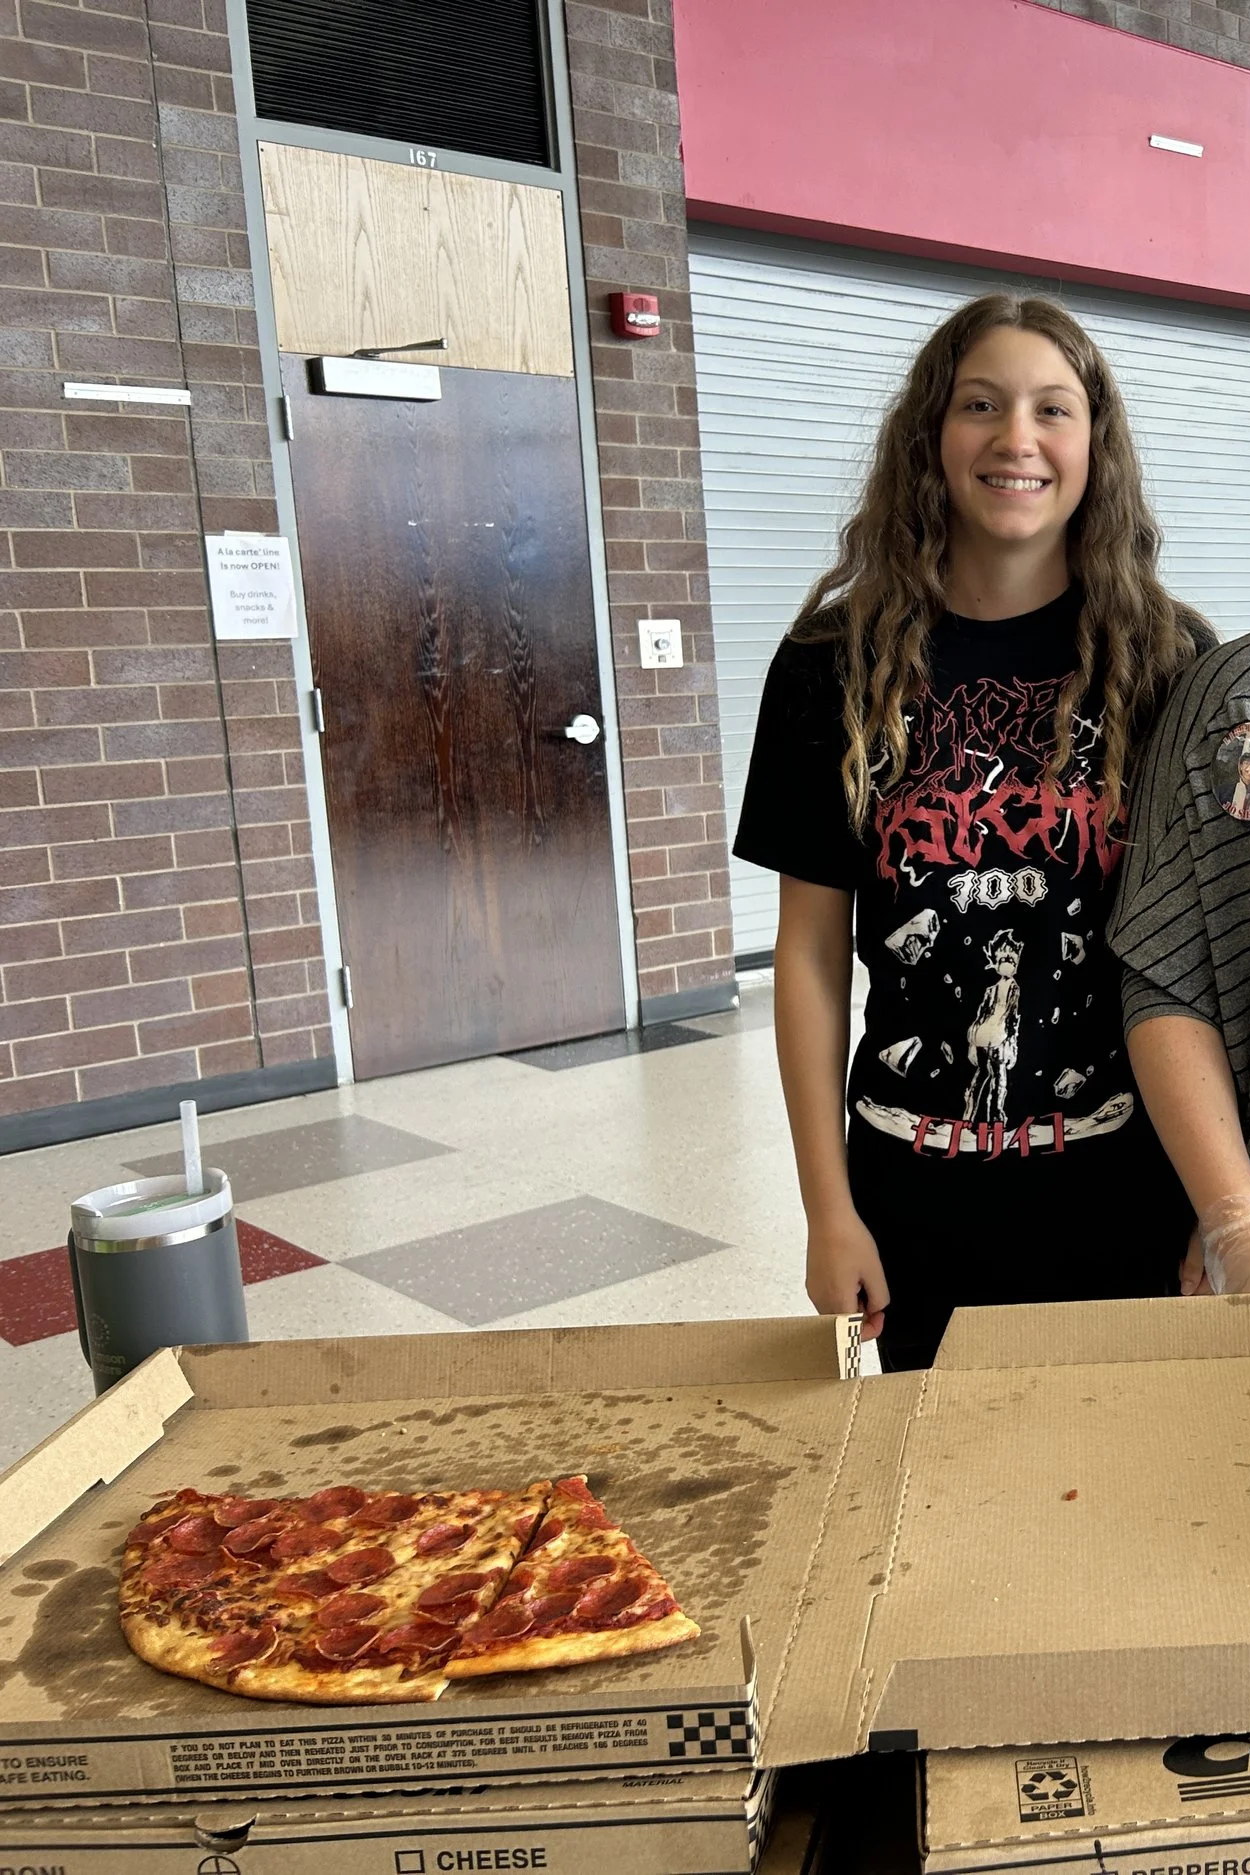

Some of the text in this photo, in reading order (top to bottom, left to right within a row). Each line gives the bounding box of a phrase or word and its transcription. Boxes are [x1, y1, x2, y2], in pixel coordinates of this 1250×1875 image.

[409, 148, 437, 168] 167
[947, 866, 1048, 914] 100
[172, 1753, 208, 1762] DEGREES
[212, 1753, 224, 1761] OR
[227, 1751, 256, 1760] BELOW
[259, 1750, 276, 1758] AND
[280, 1748, 301, 1757] THEN
[305, 1746, 345, 1756] REHEATED
[350, 1745, 369, 1753] JUST
[373, 1743, 398, 1752] PRIOR
[401, 1742, 412, 1750] TO
[416, 1739, 476, 1750] CONSUMPTION.
[500, 1736, 520, 1744] BEST
[523, 1734, 558, 1743] RESULTS
[561, 1732, 594, 1741] REMOVE
[598, 1730, 621, 1739] PIZZA
[624, 1729, 648, 1737] FROM
[181, 1744, 198, 1752] YOU
[202, 1743, 214, 1751] DO
[219, 1742, 235, 1750] NOT
[239, 1741, 261, 1749] PLAN
[264, 1740, 276, 1748] TO
[280, 1739, 294, 1747] EAT
[298, 1738, 317, 1746] THIS
[321, 1736, 345, 1745] PIZZA
[348, 1735, 377, 1744] WITHIN
[451, 1727, 493, 1738] PURCHASE
[560, 1720, 619, 1731] REFRIGERATED
[622, 1719, 633, 1727] AT
[3, 1754, 89, 1769] TO ENSURE
[216, 1761, 242, 1770] PLACE
[280, 1758, 301, 1767] OVEN
[306, 1757, 344, 1766] DIRECTLY
[349, 1756, 360, 1764] ON
[384, 1753, 406, 1761] OVEN
[411, 1751, 433, 1760] RACK
[512, 1745, 535, 1754] UNTIL
[552, 1742, 588, 1751] REACHES
[612, 1738, 648, 1747] DEGREES
[31, 1770, 91, 1783] EATING.
[203, 1773, 219, 1781] THE
[220, 1772, 251, 1780] CHEESE
[252, 1769, 282, 1779] BEGINS
[283, 1769, 295, 1777] TO
[296, 1768, 332, 1777] FURTHER
[334, 1766, 364, 1775] BROWN
[365, 1765, 377, 1773] OR
[378, 1763, 410, 1772] BUBBLE
[412, 1761, 435, 1770] 10-12
[1030, 1802, 1072, 1812] PAPER
[1040, 1810, 1066, 1820] BOX
[436, 1848, 548, 1871] CHEESE
